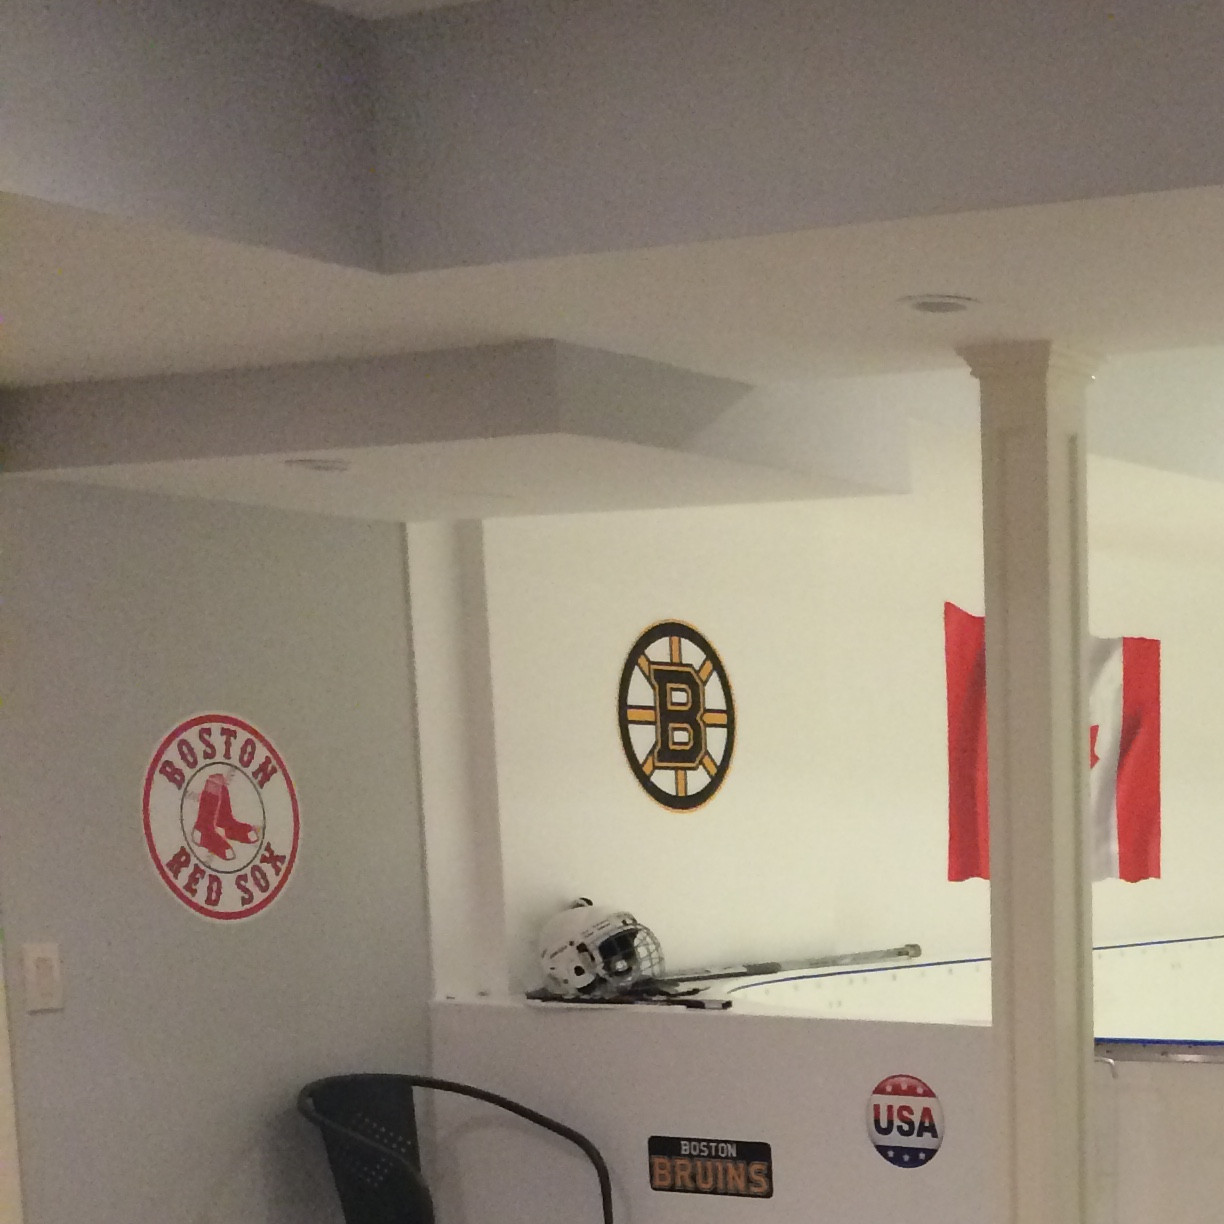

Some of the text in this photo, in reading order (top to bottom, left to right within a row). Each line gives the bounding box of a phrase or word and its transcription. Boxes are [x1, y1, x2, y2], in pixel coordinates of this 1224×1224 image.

[648, 661, 706, 770] B
[159, 727, 278, 789] BOSTON
[166, 842, 287, 907] RED SOX
[873, 1103, 939, 1139] USA
[681, 1141, 737, 1157] BOSTON
[651, 1155, 768, 1195] BRUINS
